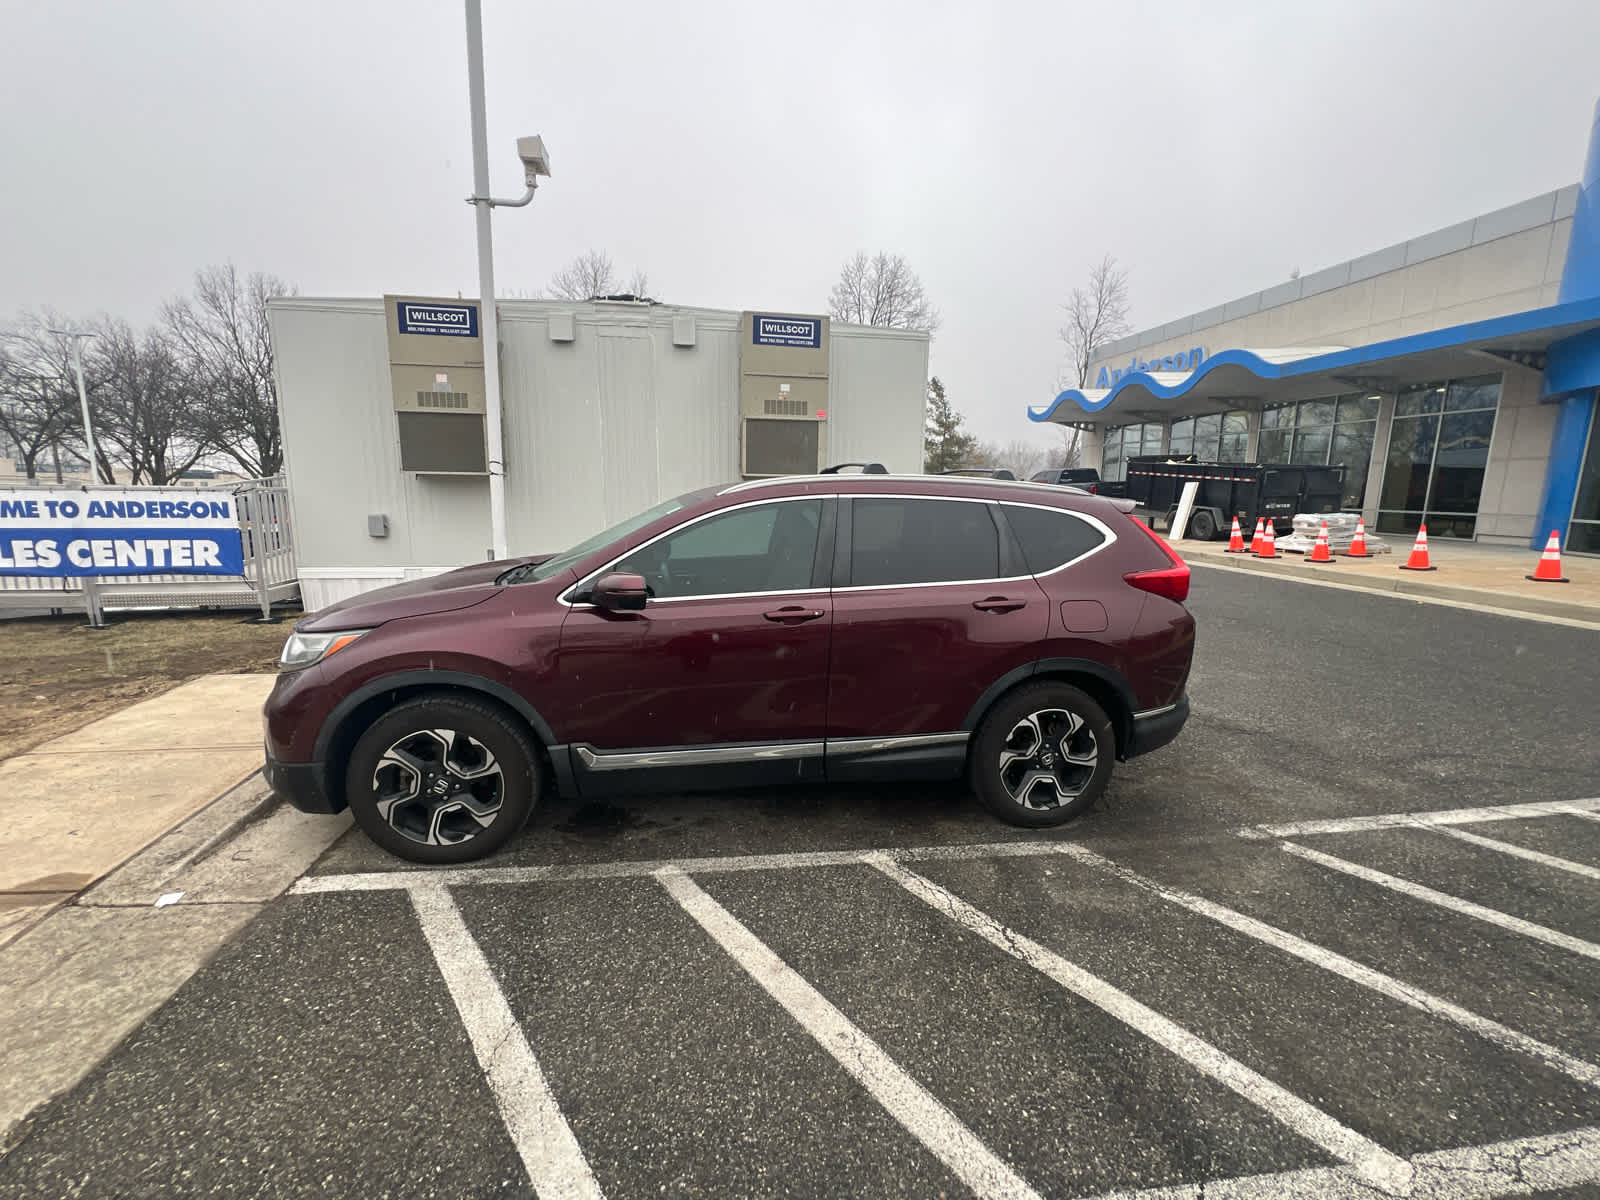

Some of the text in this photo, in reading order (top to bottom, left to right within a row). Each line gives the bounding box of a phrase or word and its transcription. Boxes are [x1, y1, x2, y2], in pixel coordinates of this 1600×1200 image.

[411, 311, 465, 322] WILLSCOT
[765, 323, 810, 335] WILLSCOT
[1096, 347, 1204, 389] Anderson
[44, 500, 80, 518] TO
[87, 500, 230, 519] ANDERSON
[66, 539, 222, 568] CENTER
